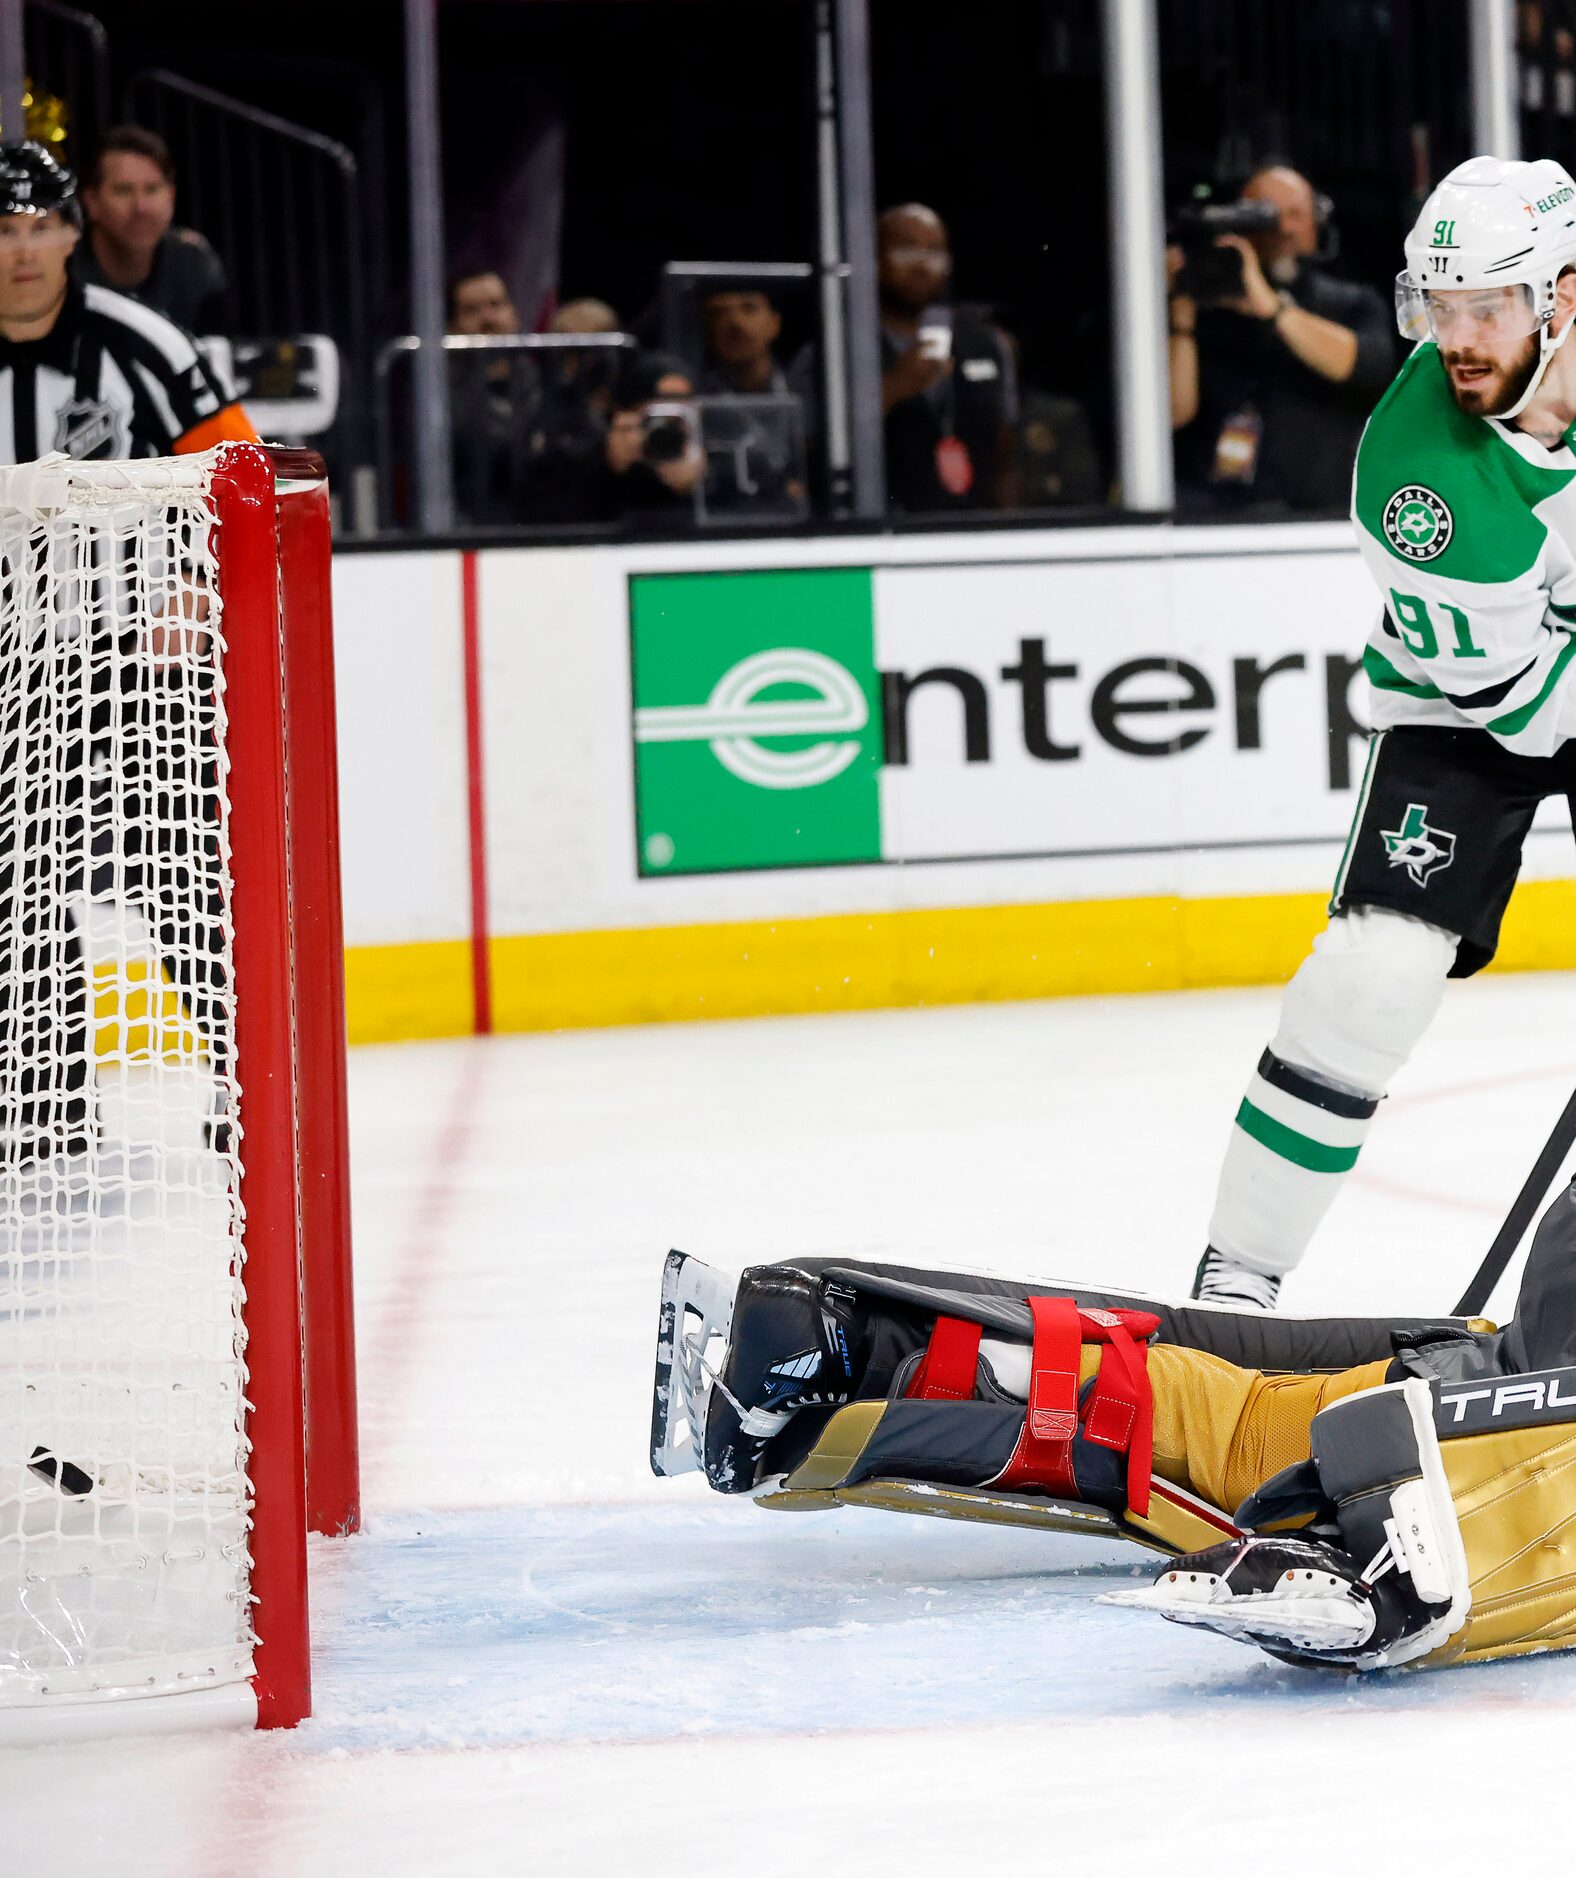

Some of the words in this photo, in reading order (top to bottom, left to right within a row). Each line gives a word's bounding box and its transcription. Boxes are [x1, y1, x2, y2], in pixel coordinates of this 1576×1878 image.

[1432, 220, 1456, 246] 91
[1393, 490, 1449, 530] DALLAS
[1387, 523, 1438, 557] STARS
[1389, 587, 1487, 659] 91
